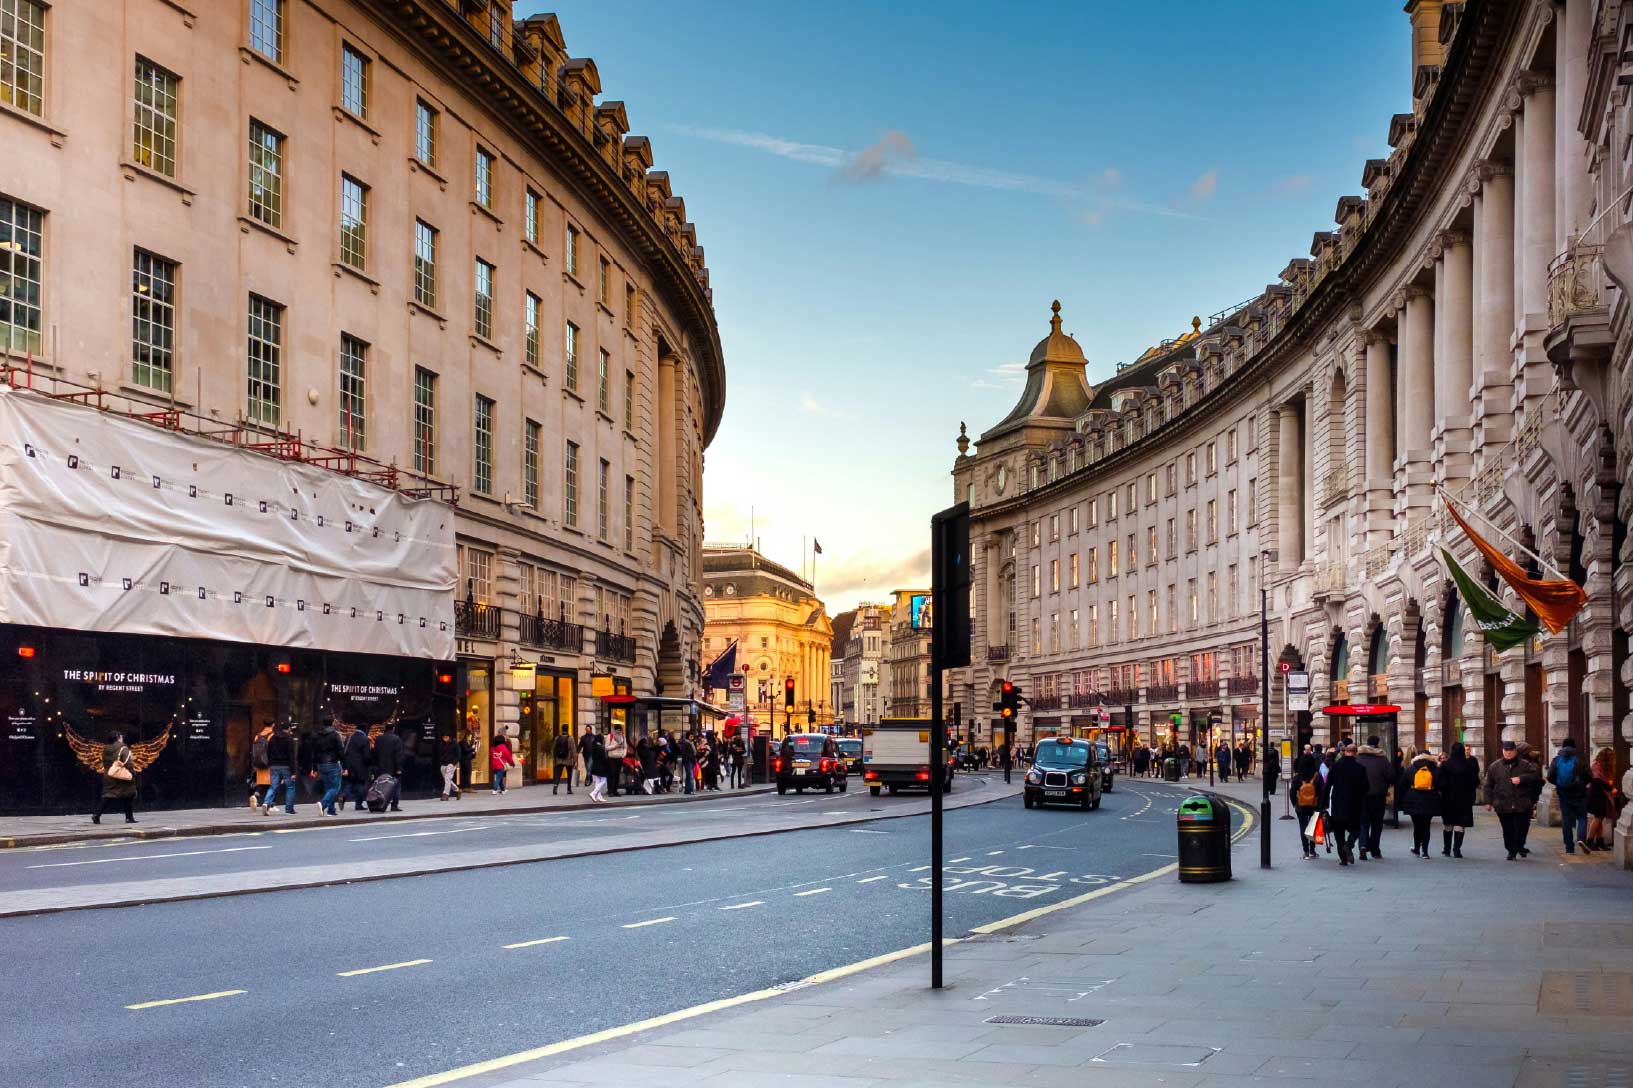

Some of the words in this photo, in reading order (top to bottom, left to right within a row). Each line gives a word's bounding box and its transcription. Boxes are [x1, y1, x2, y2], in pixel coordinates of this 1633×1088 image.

[1282, 663, 1290, 671] D
[64, 670, 81, 680] THE
[113, 672, 126, 682] OF
[127, 673, 175, 684] CHRISTMAS
[331, 684, 342, 693] THE
[360, 686, 368, 694] OF
[368, 686, 398, 695] CHRISTMAS
[897, 877, 1063, 899] BUS
